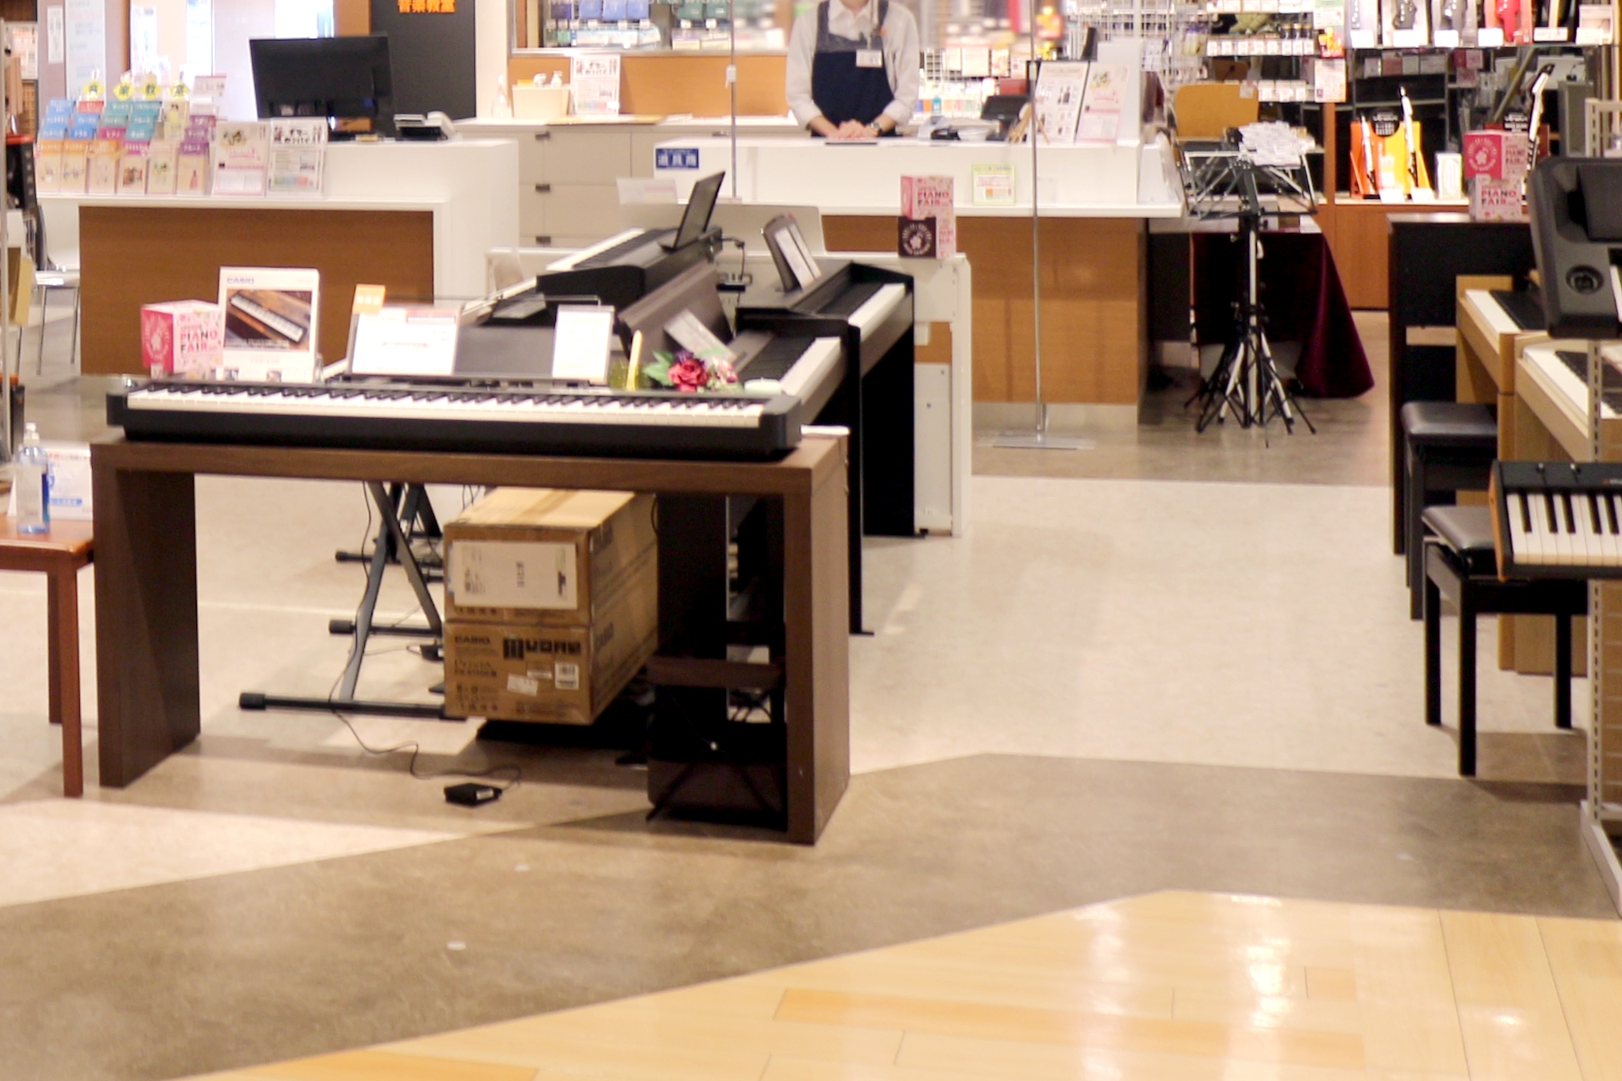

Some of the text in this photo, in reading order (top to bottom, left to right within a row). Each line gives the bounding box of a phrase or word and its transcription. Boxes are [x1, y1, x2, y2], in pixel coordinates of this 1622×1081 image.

[917, 191, 950, 199] PIANO
[1481, 189, 1517, 198] PIANO
[917, 199, 941, 207] FAIR
[1481, 198, 1507, 206] FAIR
[180, 330, 218, 342] PIANO
[180, 343, 209, 354] FAIR
[454, 635, 491, 644] CASIO
